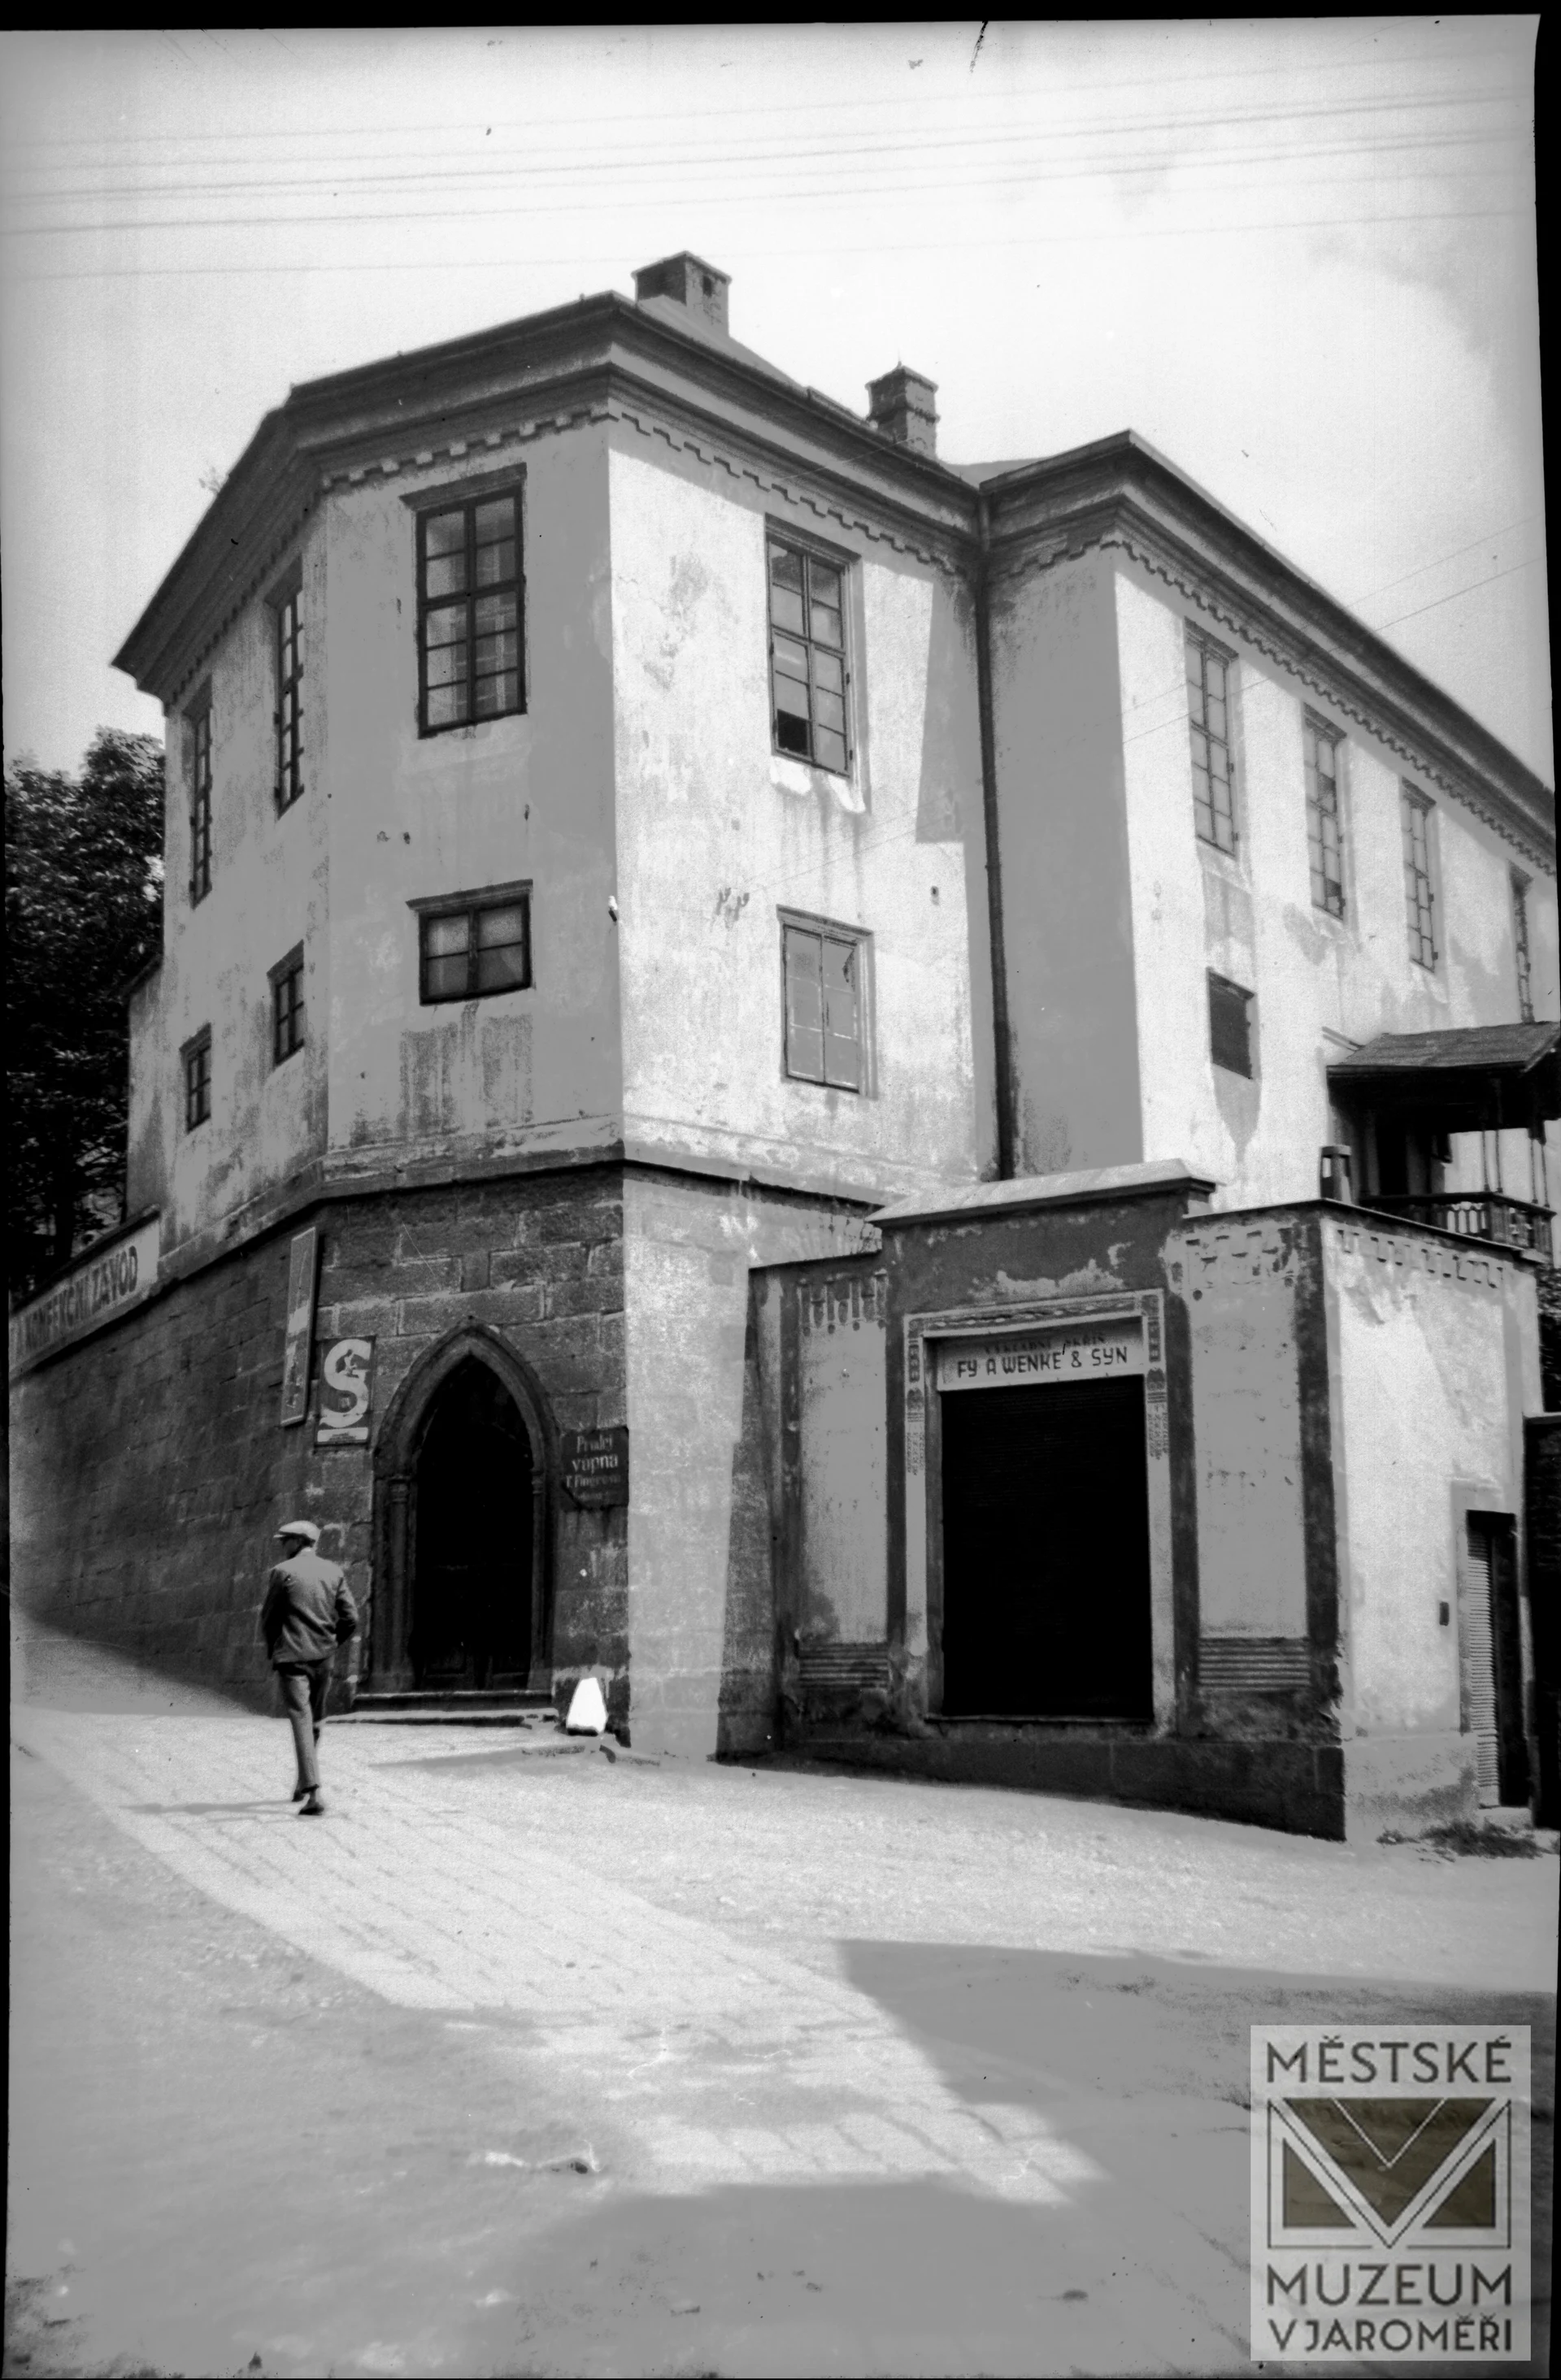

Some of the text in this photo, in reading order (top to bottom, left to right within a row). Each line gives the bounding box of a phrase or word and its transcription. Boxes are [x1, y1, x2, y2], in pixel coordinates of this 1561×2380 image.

[1002, 1353, 1062, 1373] WENKE
[1071, 1350, 1082, 1368] &
[1092, 1346, 1128, 1366] SYN
